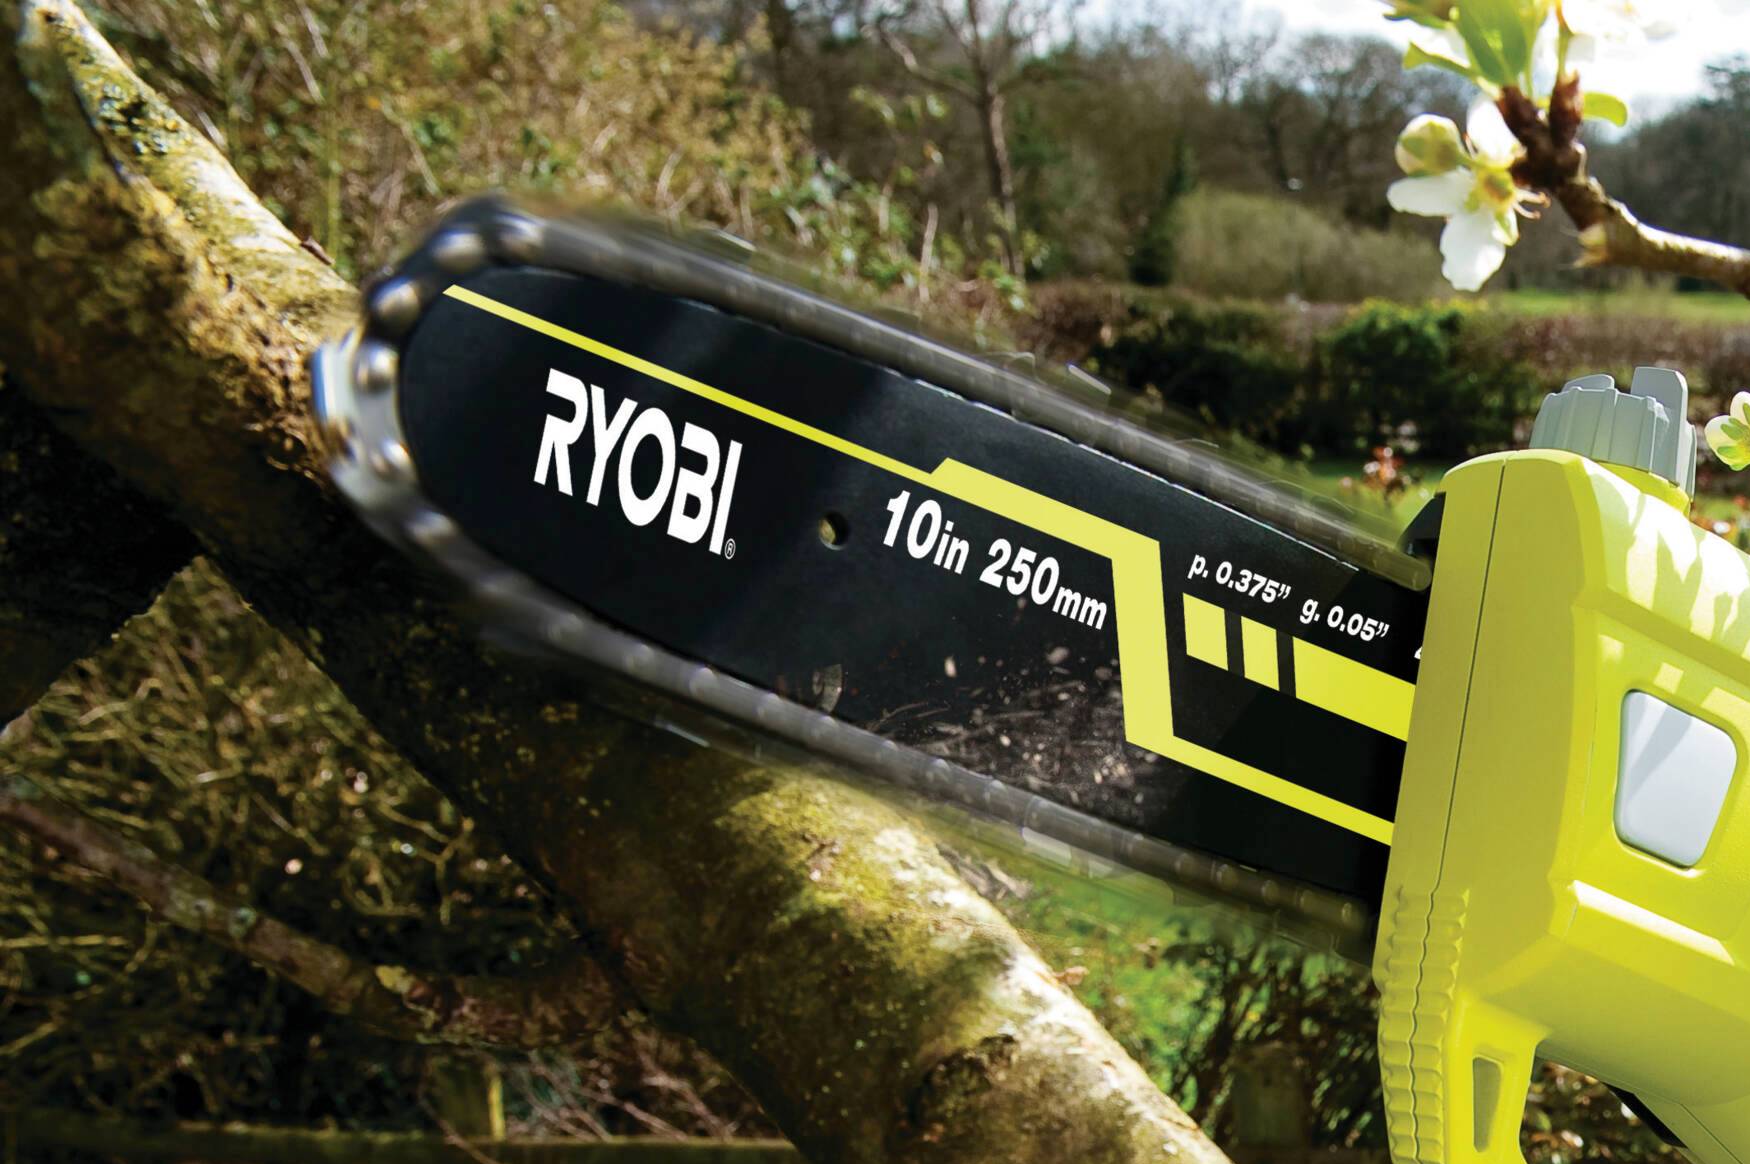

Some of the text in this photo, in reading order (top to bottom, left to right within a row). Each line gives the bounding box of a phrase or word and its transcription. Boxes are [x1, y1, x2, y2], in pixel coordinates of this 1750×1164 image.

[534, 368, 743, 557] RYOBI
[883, 490, 1108, 631] 10in 250mm
